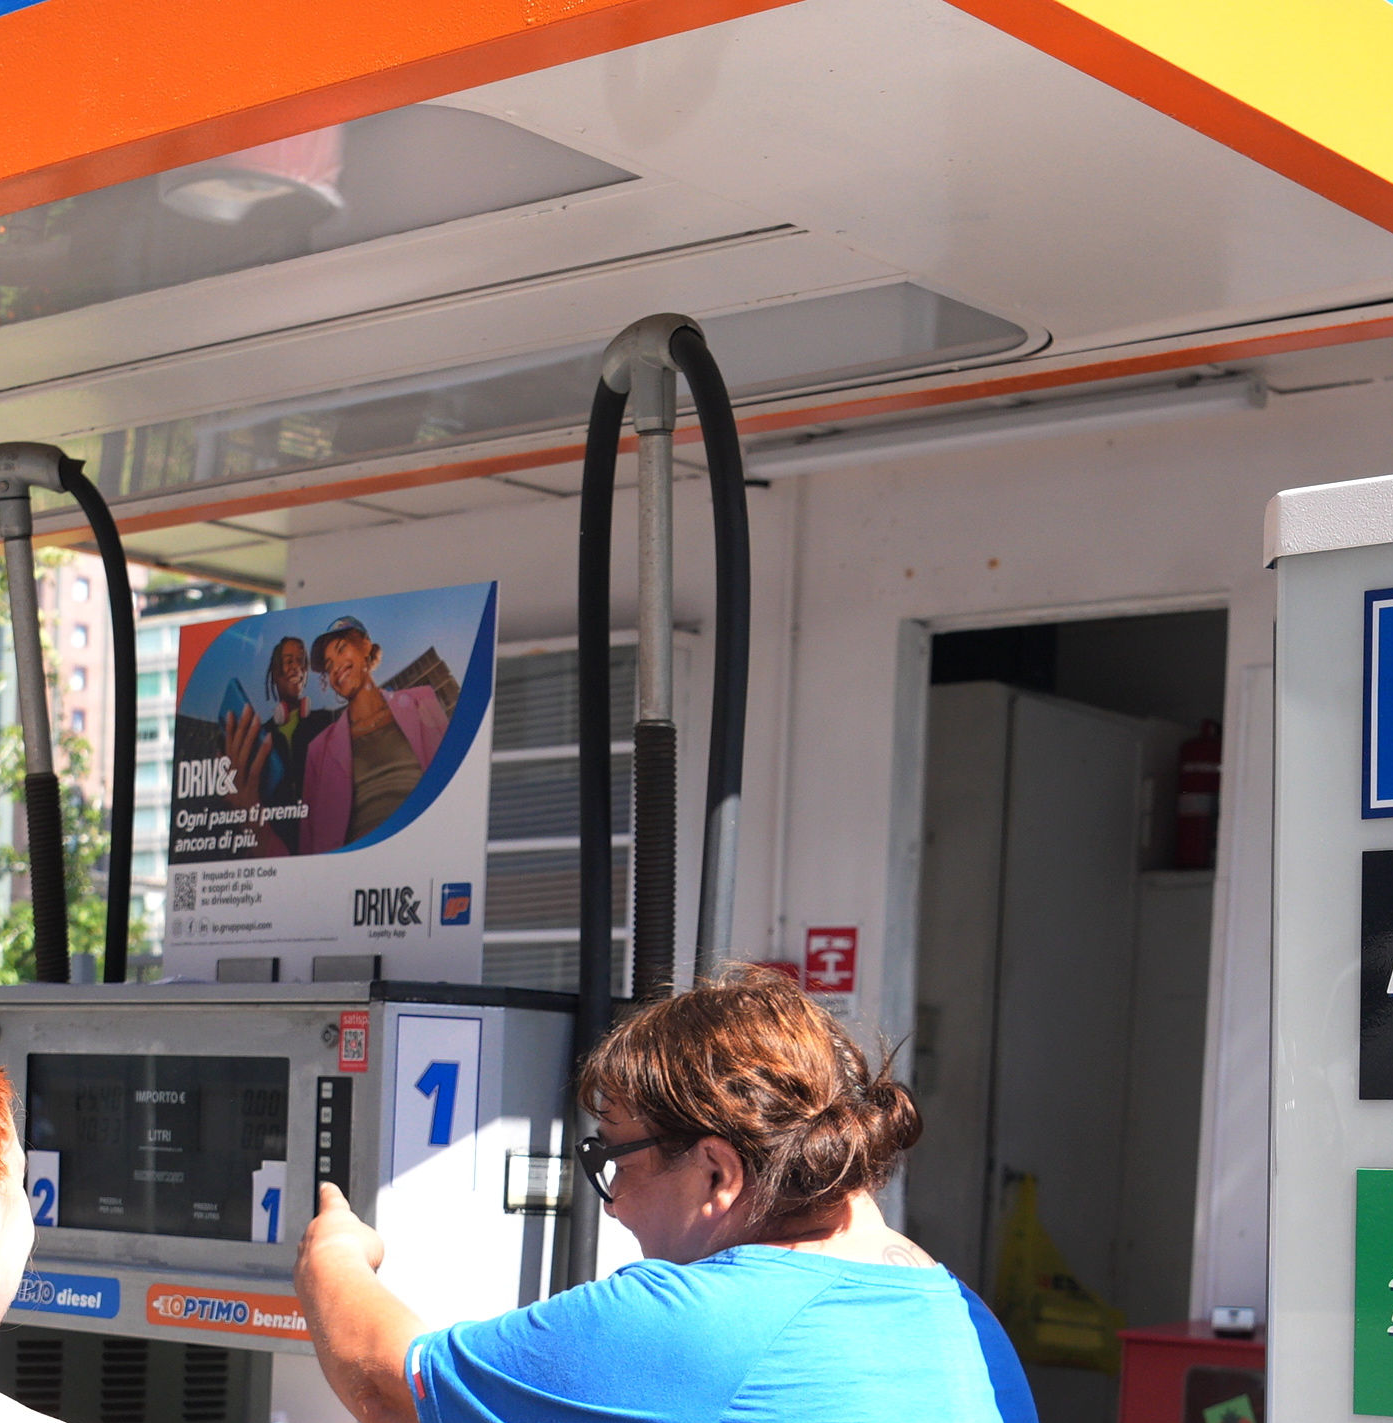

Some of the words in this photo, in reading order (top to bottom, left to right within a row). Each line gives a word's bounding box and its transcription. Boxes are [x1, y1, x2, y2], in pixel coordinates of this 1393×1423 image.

[175, 808, 209, 832] Ogni
[208, 808, 247, 831] pausa
[249, 803, 260, 822] ti
[259, 800, 309, 827] premia
[174, 835, 216, 853] ancora
[217, 829, 233, 849] di
[232, 828, 258, 854] più.
[202, 868, 235, 883] Inquadra
[243, 867, 256, 879] QR
[257, 866, 277, 877] Code
[208, 883, 231, 896] scopri
[135, 1090, 178, 1104] IMPORTO
[179, 1091, 186, 1104] €
[414, 1058, 460, 1147] 1
[148, 1128, 172, 1142] LITRI
[32, 1178, 55, 1226] 2
[261, 1187, 281, 1243] 1
[56, 1287, 102, 1309] diesel
[168, 1294, 249, 1324] OPTIMO
[253, 1305, 308, 1331] benzin
